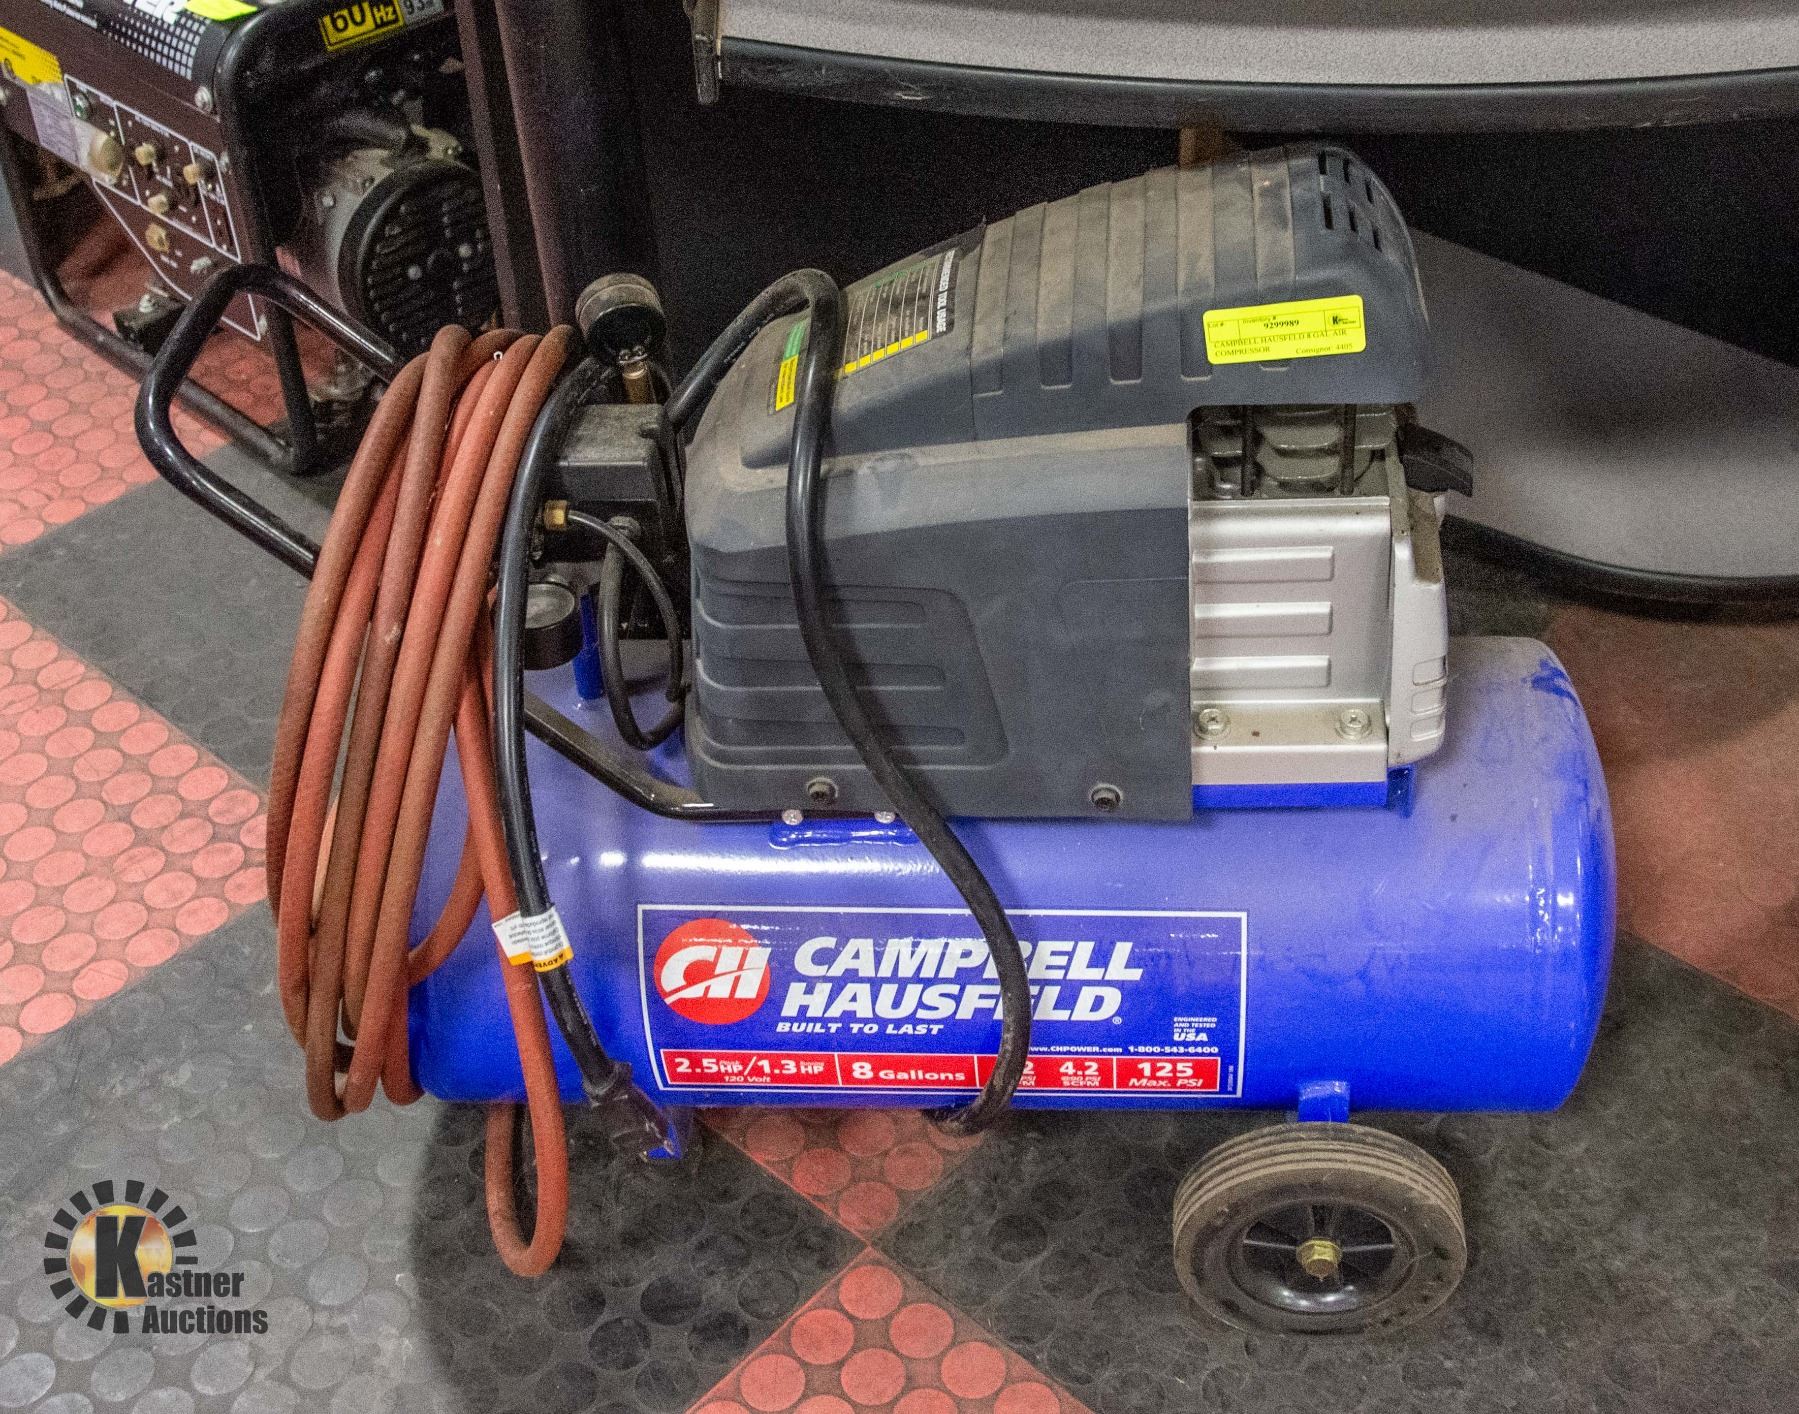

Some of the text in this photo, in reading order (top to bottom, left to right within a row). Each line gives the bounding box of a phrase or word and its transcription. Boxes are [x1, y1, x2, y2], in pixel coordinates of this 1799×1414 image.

[1264, 319, 1300, 329] 9299989
[1214, 337, 1259, 349] CAMPBELL
[1215, 346, 1270, 357] COMPRESSOR
[776, 1022, 944, 1036] BUILT TO LAST
[1173, 1032, 1208, 1042] USA
[1128, 1045, 1219, 1054] 1-800-543-6400
[851, 1061, 966, 1082] 8 Gallons
[1059, 1061, 1099, 1076] 4.2
[1137, 1062, 1194, 1078] 125
[723, 1075, 744, 1083] 120
[1128, 1078, 1203, 1087] Max. PSI
